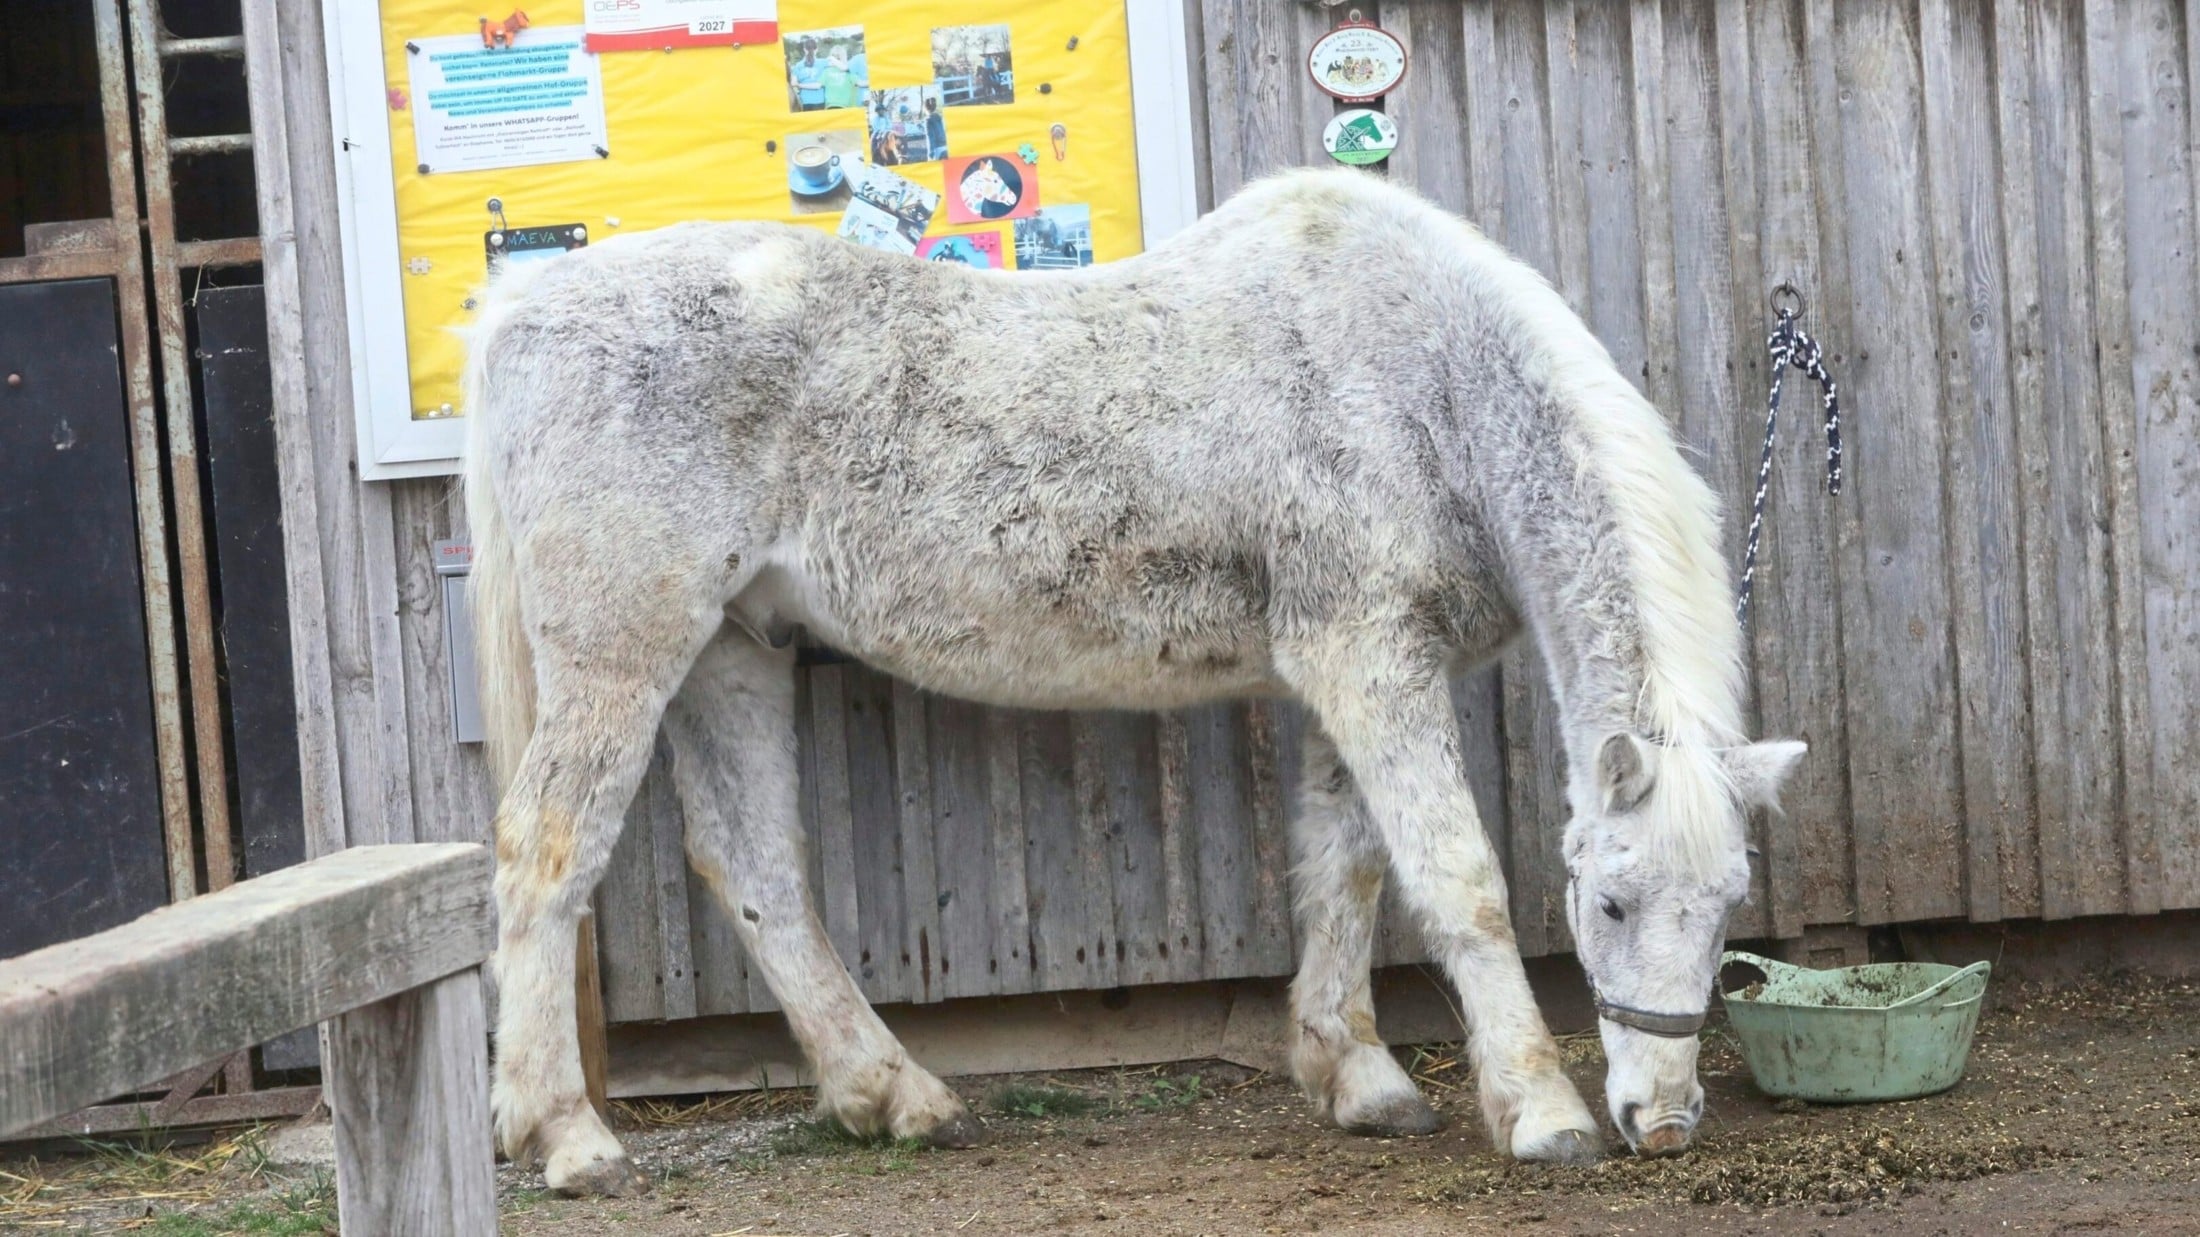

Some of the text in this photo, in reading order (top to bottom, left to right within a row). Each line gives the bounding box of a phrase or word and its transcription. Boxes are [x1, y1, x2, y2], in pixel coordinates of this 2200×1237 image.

[699, 21, 725, 31] 2027
[514, 55, 527, 64] Wir
[528, 53, 552, 63] haben
[553, 52, 569, 60] eine
[497, 83, 543, 94] allgemeinen
[544, 79, 587, 89] Hof-Gruppe
[480, 120, 502, 128] unsere
[504, 112, 579, 126] WHATSAPP-Gruppen!
[507, 232, 557, 246] MAEVA
